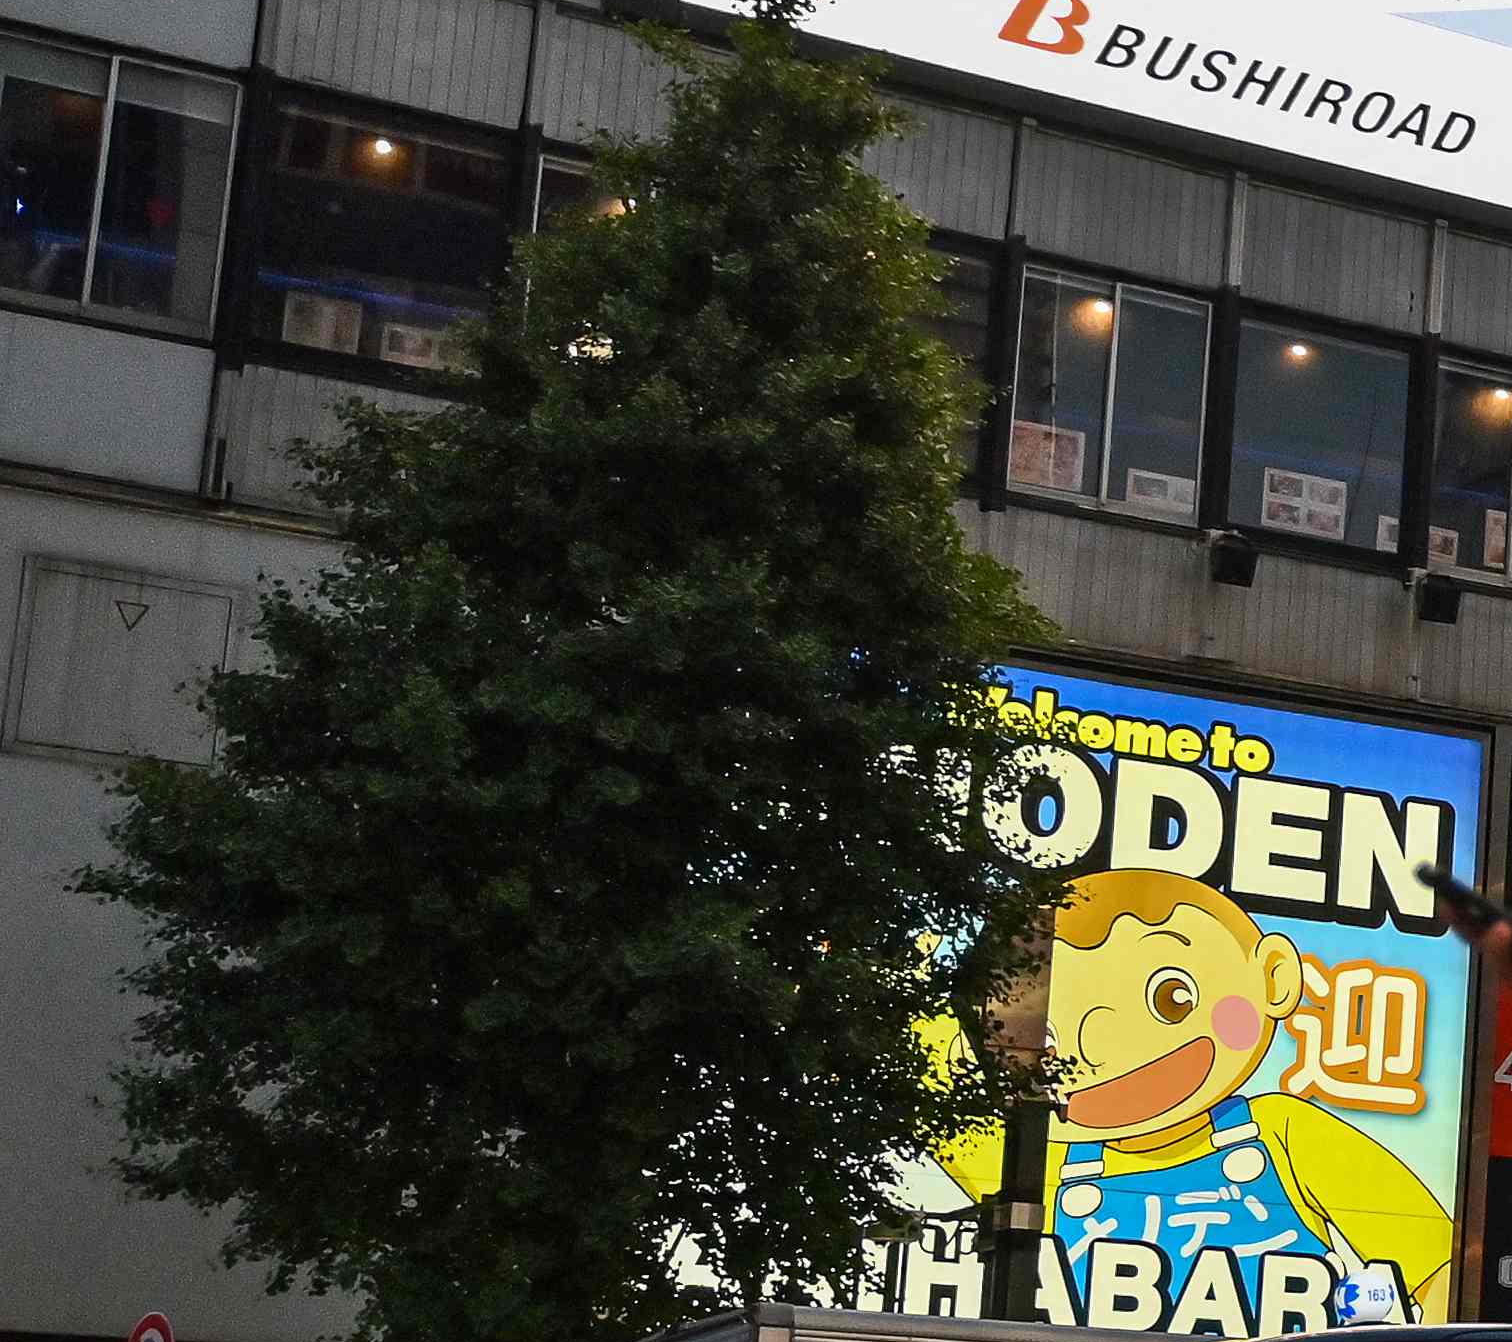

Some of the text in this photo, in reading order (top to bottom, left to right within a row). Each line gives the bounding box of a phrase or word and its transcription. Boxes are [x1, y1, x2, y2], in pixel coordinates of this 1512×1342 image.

[1094, 24, 1478, 156] BUSHIROAD
[1209, 721, 1274, 774] to
[1295, 965, 1423, 1109] 迎
[1365, 1288, 1388, 1304] 163
